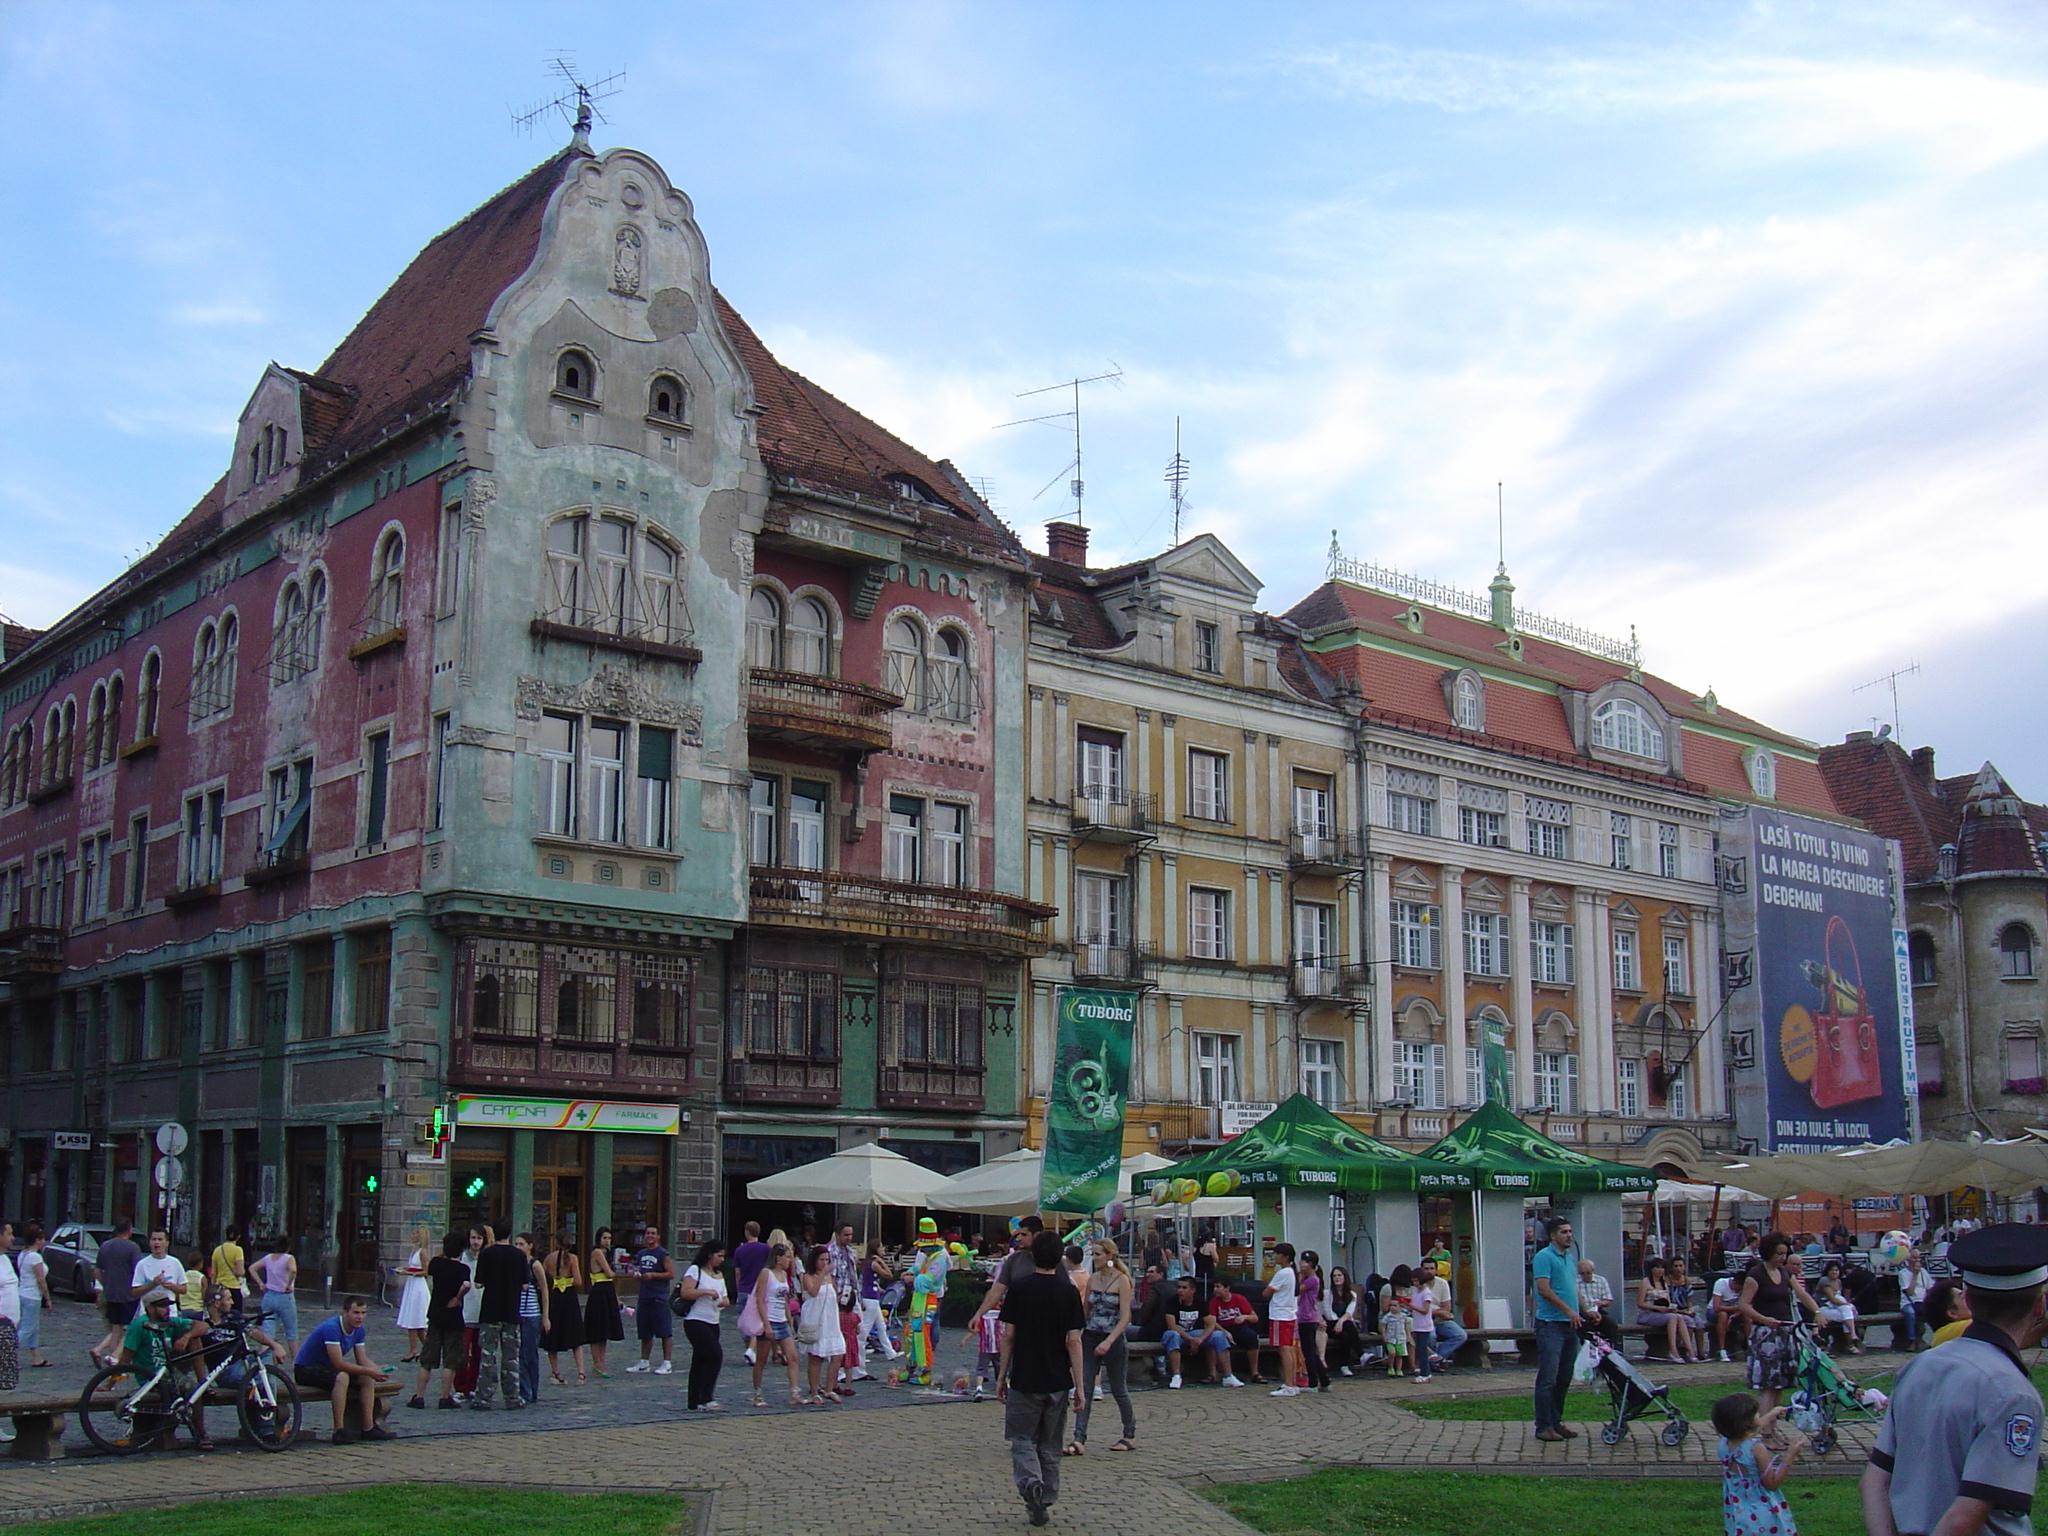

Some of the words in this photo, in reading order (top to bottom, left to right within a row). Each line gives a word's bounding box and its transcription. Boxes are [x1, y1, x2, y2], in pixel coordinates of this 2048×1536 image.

[1760, 824, 1792, 850] LASĂ
[1793, 832, 1829, 858] TOTUL
[1842, 844, 1869, 867] VINO
[1762, 853, 1779, 876] LA
[1782, 858, 1820, 884] MAREA
[1822, 867, 1885, 897] DESCHIDERE
[1763, 883, 1823, 913] DEDEMAN!
[1078, 1004, 1133, 1022] TUBORG
[1899, 962, 1916, 1082] CONSTRUCTIM
[1776, 1119, 1794, 1136] DIN
[1795, 1121, 1808, 1137] 30
[1834, 1119, 1845, 1138] ÎN
[1846, 1123, 1871, 1139] LOCUL
[67, 1135, 88, 1145] KSS
[1299, 1170, 1337, 1183] TUBORG
[1420, 1174, 1439, 1186] OPEN
[1441, 1174, 1456, 1186] FOR
[1493, 1174, 1529, 1186] TUBORG
[1606, 1176, 1625, 1187] OPEN
[1626, 1176, 1640, 1187] FOR
